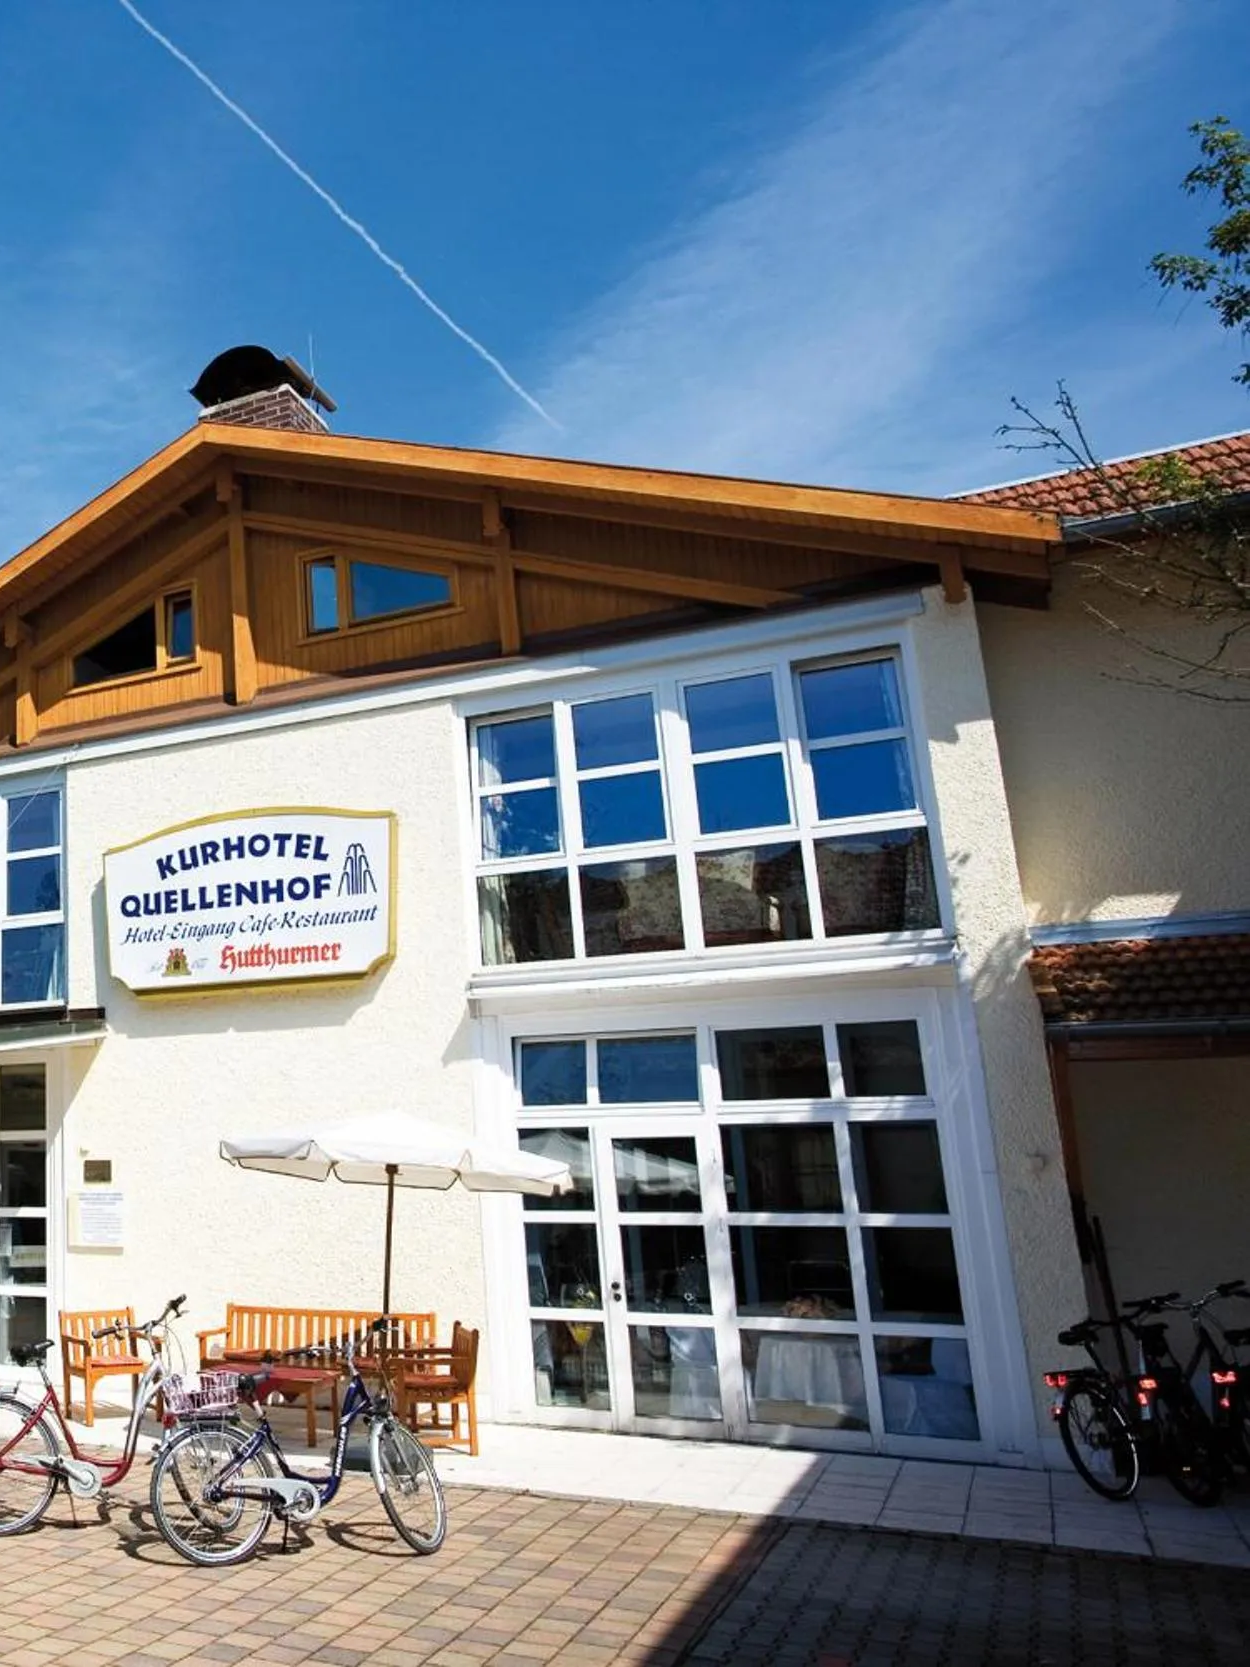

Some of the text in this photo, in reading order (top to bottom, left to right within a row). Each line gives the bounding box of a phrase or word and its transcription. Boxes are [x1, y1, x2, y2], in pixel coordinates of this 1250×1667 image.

[156, 833, 330, 880] KURHOTEL
[120, 873, 332, 918] QUELLENHOF
[121, 920, 237, 945] Hotel-Eingang
[219, 942, 342, 974] Hutthurmer
